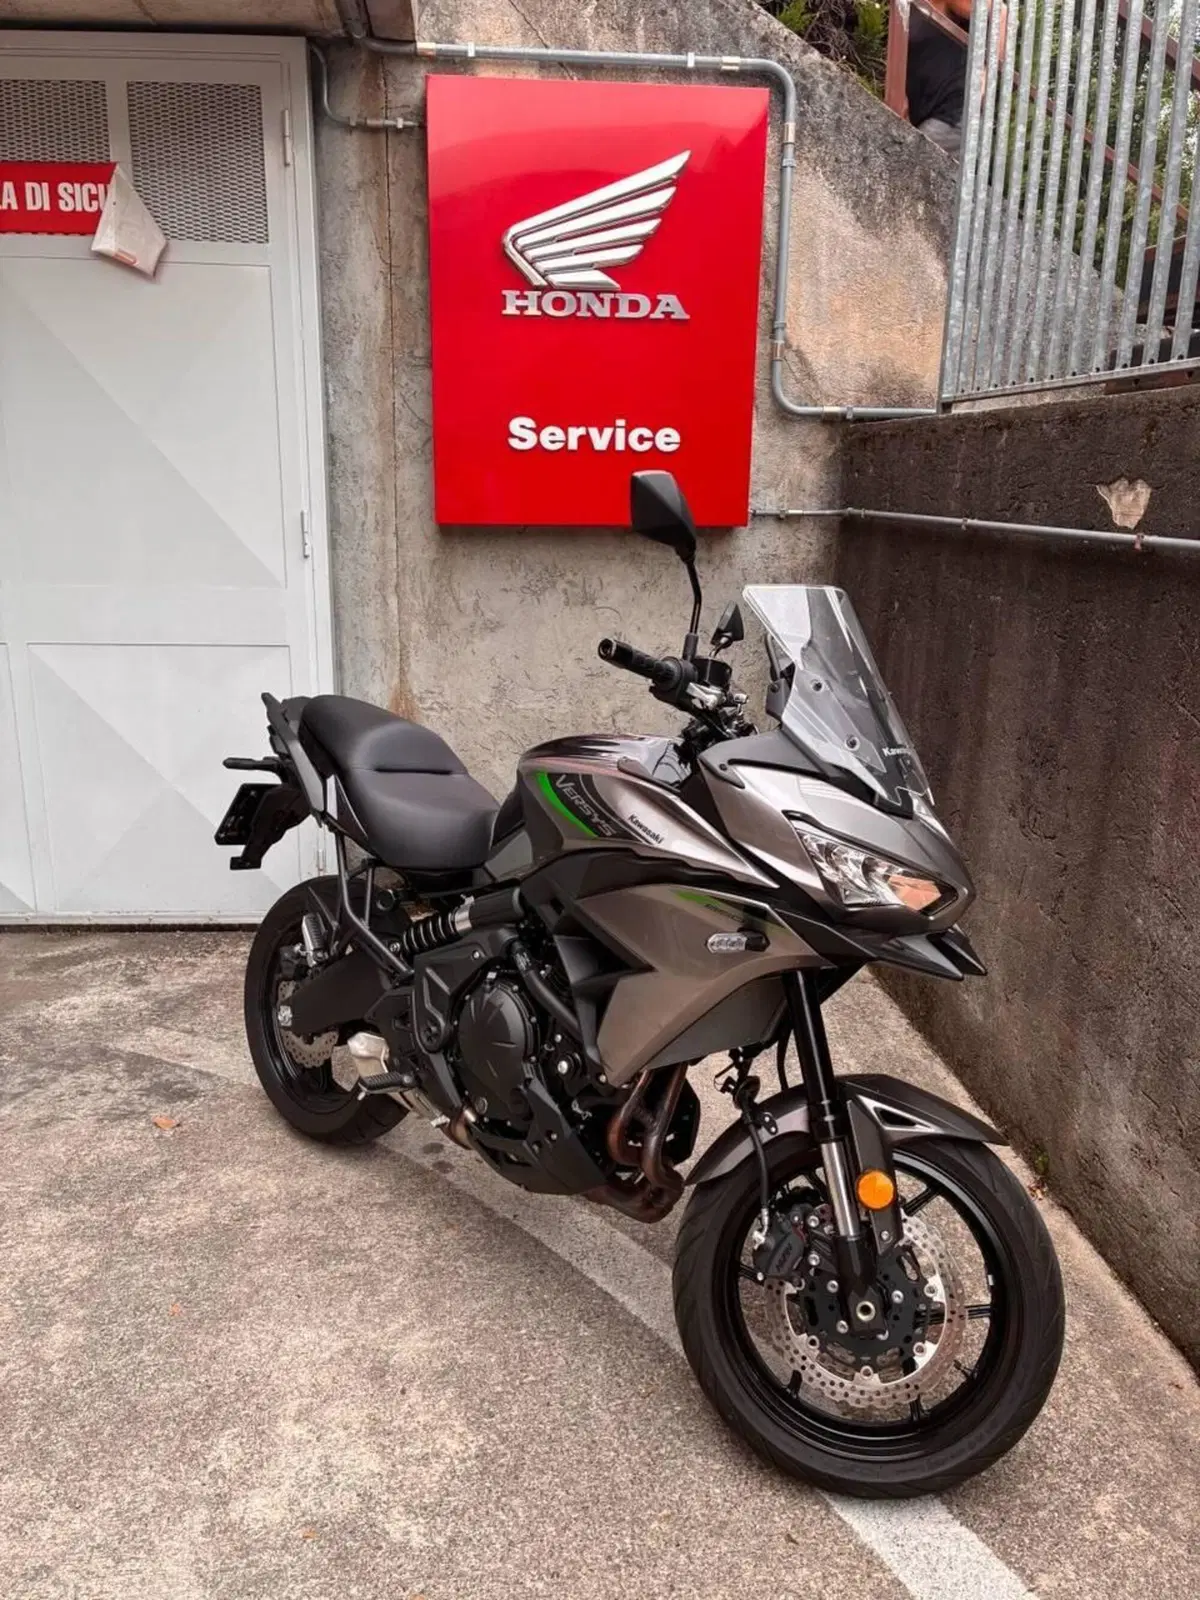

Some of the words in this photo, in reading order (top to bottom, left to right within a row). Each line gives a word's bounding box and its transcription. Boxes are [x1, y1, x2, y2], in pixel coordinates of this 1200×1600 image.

[24, 181, 51, 211] DI
[501, 289, 690, 320] HONDA
[507, 416, 681, 452] Service
[627, 813, 665, 844] Kawasaki
